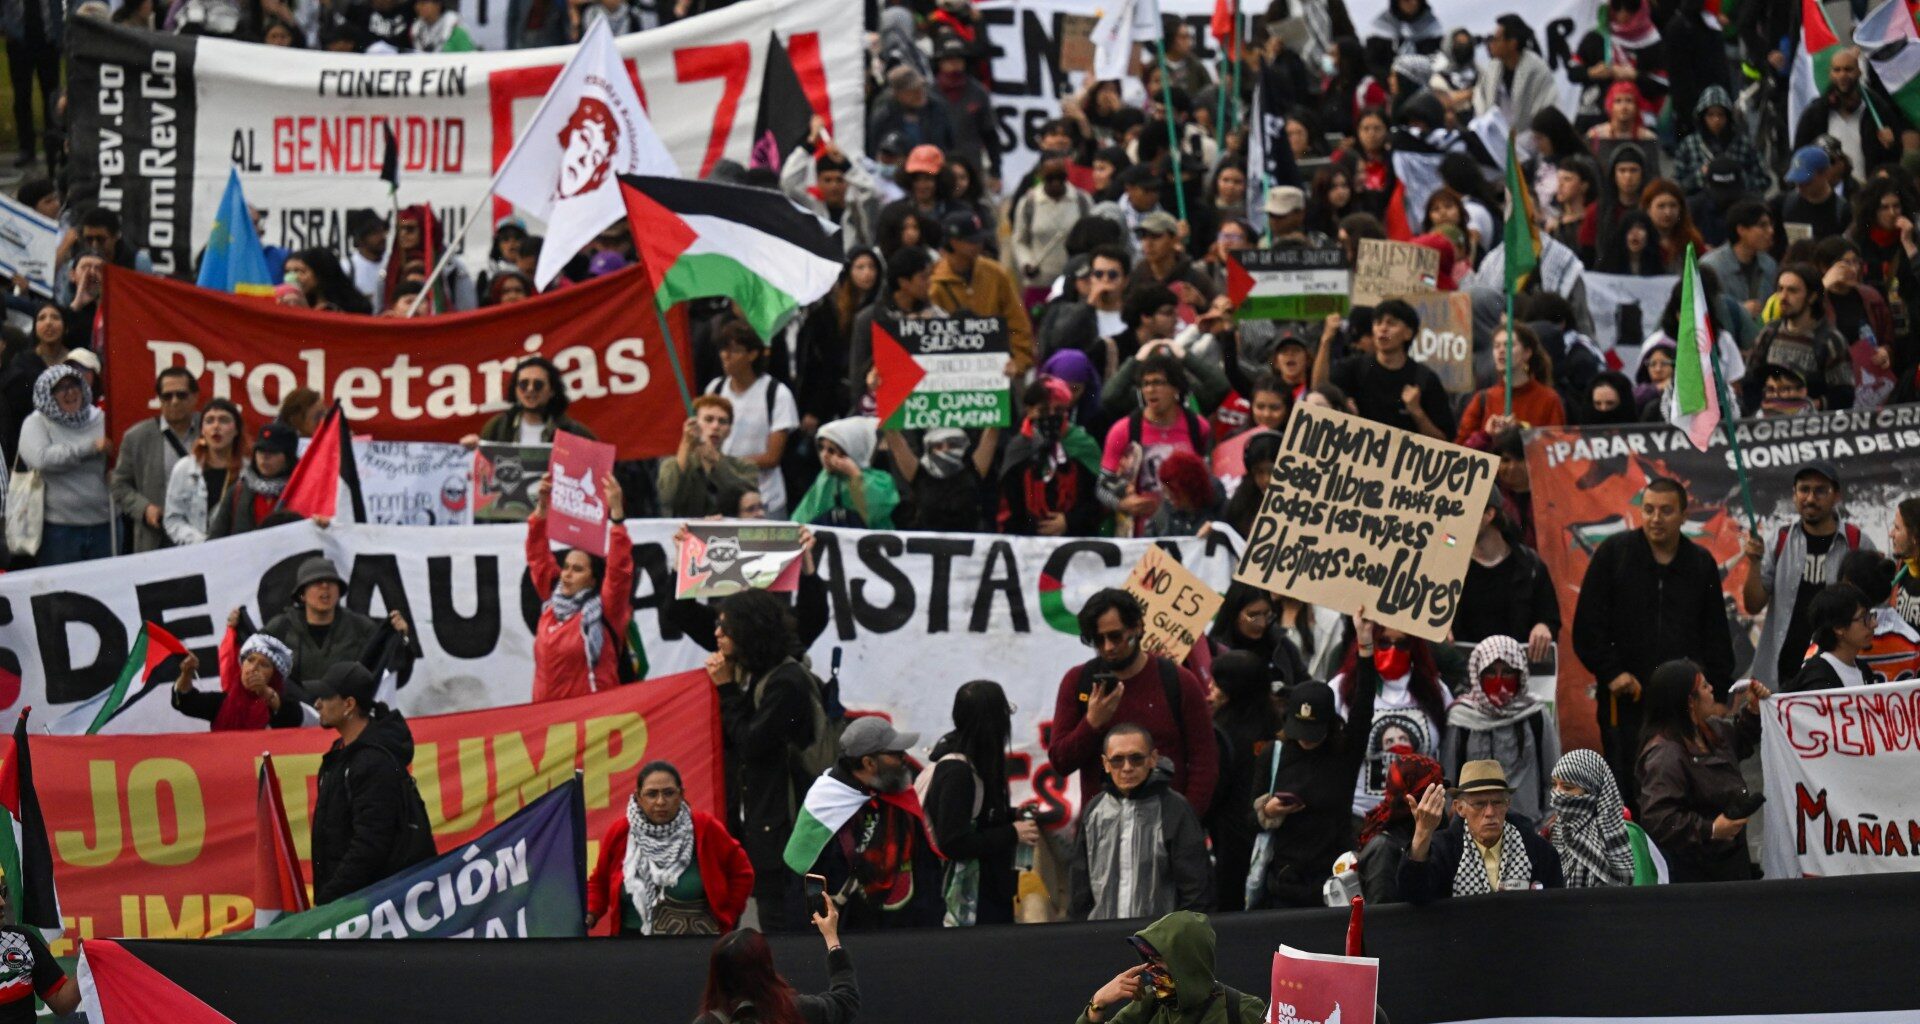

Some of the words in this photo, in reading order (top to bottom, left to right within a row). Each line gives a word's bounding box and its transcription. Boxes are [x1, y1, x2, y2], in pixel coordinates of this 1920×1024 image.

[420, 65, 467, 97] FIN
[231, 128, 263, 171] AL
[1408, 327, 1467, 363] LDITO
[904, 394, 930, 411] NO
[938, 392, 998, 411] CUANDO
[904, 409, 941, 430] LOS
[1736, 408, 1872, 444] AGRESIÓN
[1724, 437, 1853, 471] SIONISTA
[1854, 433, 1893, 454] DE
[808, 530, 1030, 641] ASTA
[1141, 566, 1172, 595] NO
[1171, 585, 1204, 617] ES
[55, 757, 206, 868] JO
[255, 711, 649, 861] TUMP
[1278, 1001, 1297, 1017] NO
